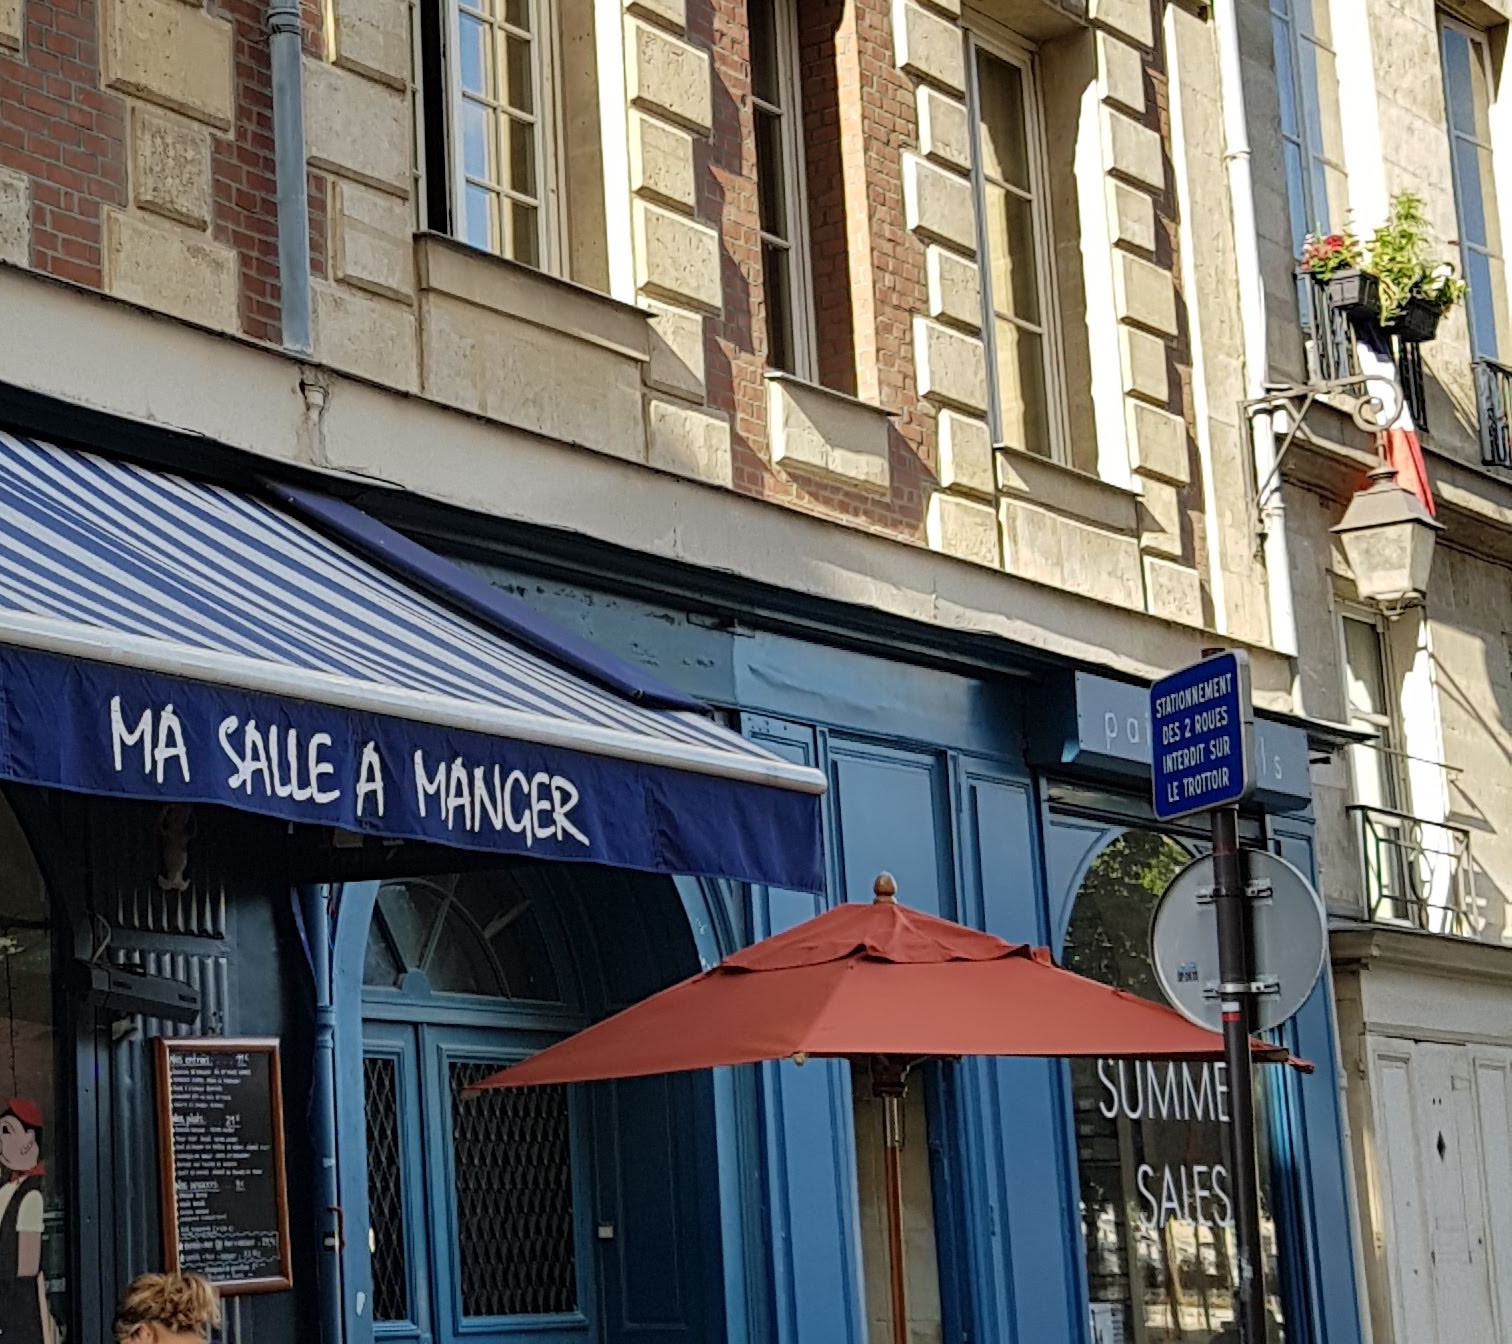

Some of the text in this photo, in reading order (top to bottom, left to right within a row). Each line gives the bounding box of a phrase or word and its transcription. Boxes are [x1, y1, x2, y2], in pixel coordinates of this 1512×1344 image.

[1155, 673, 1231, 718] STATIONNEMENT
[1162, 706, 1228, 745] DES 2 ROUES
[110, 696, 590, 848] MA SALLE A MANGER
[1163, 736, 1230, 774] INTERDIT SUR
[1167, 767, 1230, 803] LE TROTTOIR
[1097, 1058, 1231, 1122] SUMME
[1137, 1163, 1231, 1229] SALES
